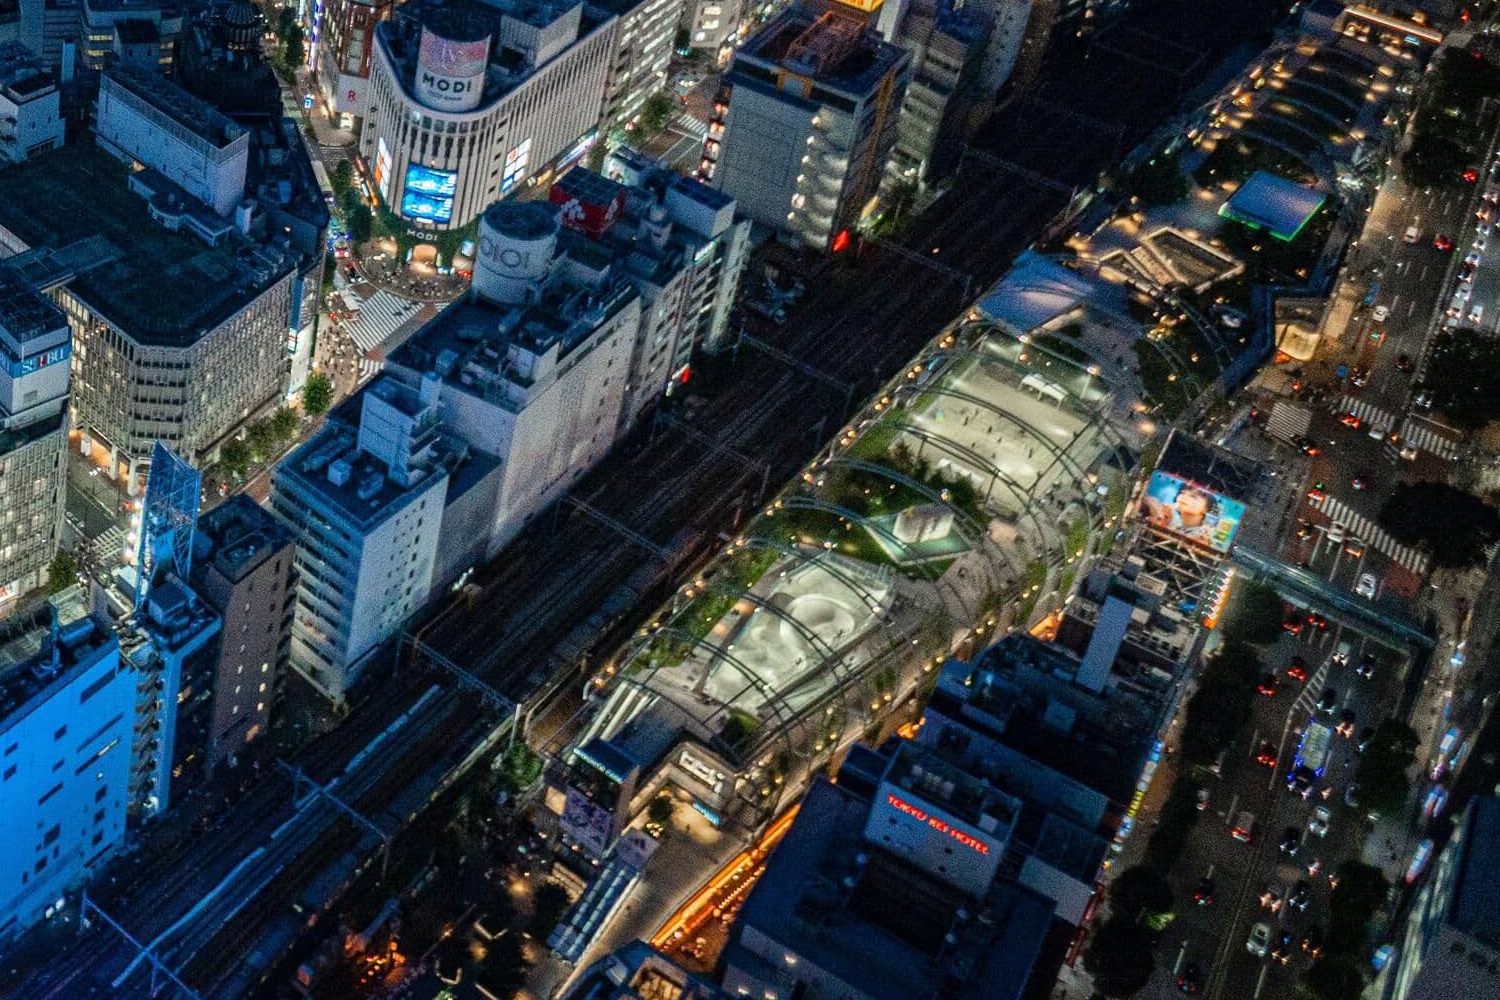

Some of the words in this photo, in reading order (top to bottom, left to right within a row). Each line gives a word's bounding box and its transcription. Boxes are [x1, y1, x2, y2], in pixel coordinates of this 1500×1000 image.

[422, 73, 472, 93] MODI
[407, 229, 438, 242] MODI
[21, 348, 64, 374] SEIBU
[887, 793, 928, 821] TOKYO
[949, 829, 989, 856] HOTEL
